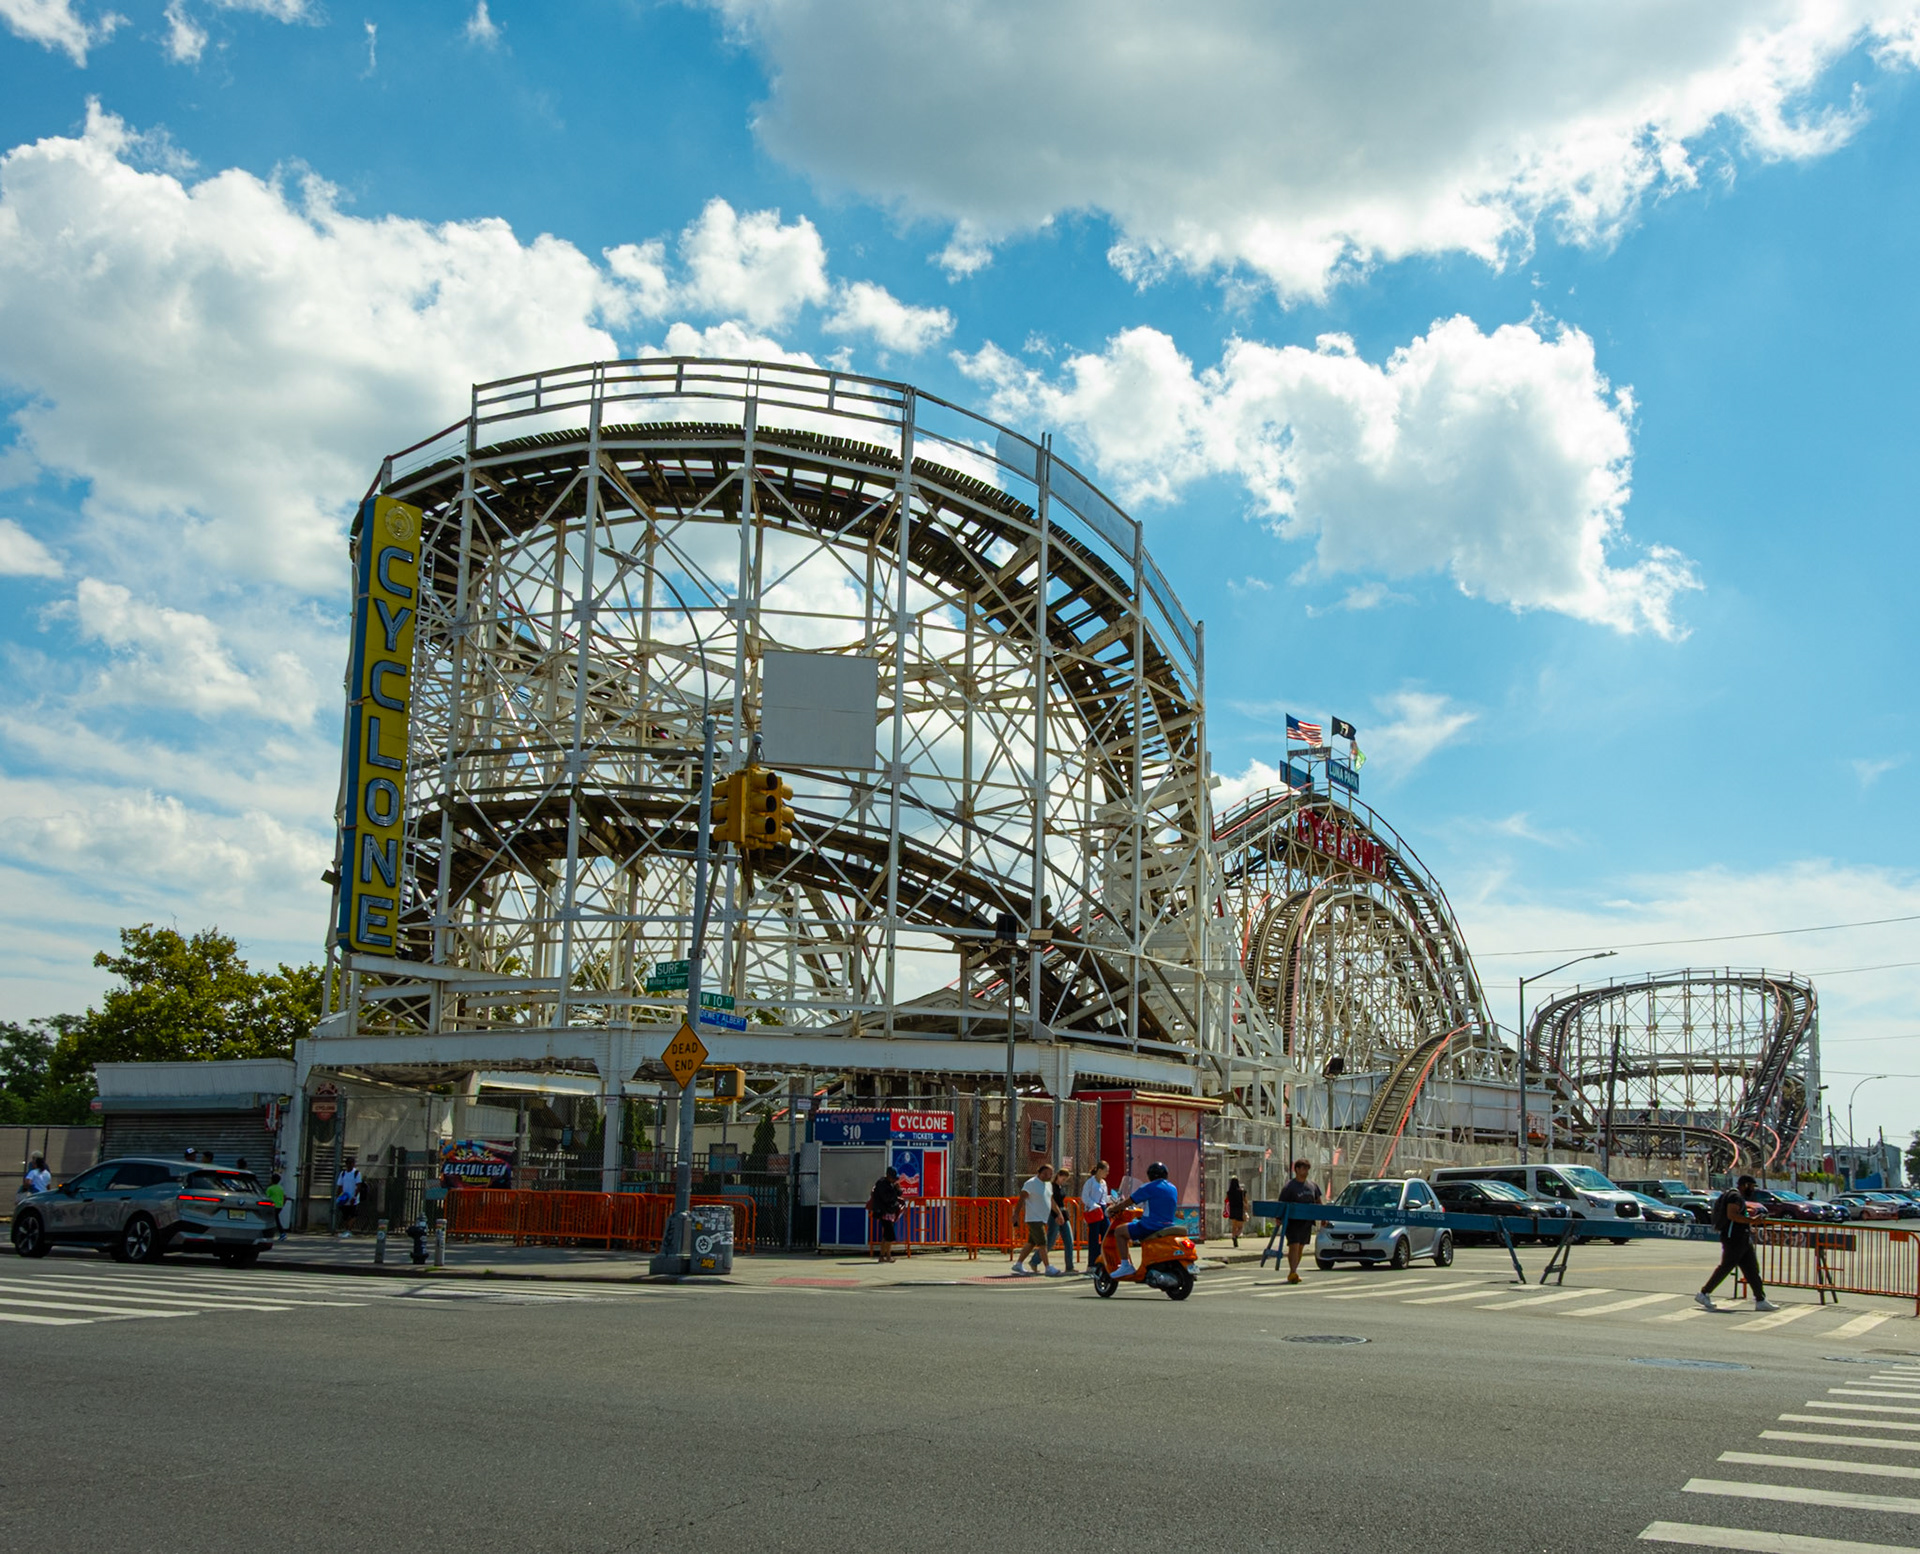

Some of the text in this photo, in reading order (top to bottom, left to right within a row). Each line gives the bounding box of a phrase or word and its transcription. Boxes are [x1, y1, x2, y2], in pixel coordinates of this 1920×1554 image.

[357, 546, 413, 947] CYCLONE
[1330, 763, 1358, 789] LUNA PARK
[1298, 806, 1387, 880] CYCLONE
[657, 963, 680, 975] SURF
[702, 994, 710, 1005] W
[713, 996, 723, 1007] 10
[700, 1010, 745, 1026] DEWEY ALBERT
[672, 1042, 698, 1055] DEAD
[675, 1059, 694, 1071] END
[830, 1114, 875, 1124] CYCLONE
[898, 1115, 948, 1130] CYCLONE
[843, 1125, 861, 1140] $10
[912, 1132, 934, 1140] TICKETS
[443, 1164, 507, 1176] ELECTRIC EDEN
[1372, 1209, 1386, 1217] LINE
[1423, 1213, 1445, 1221] CROSS
